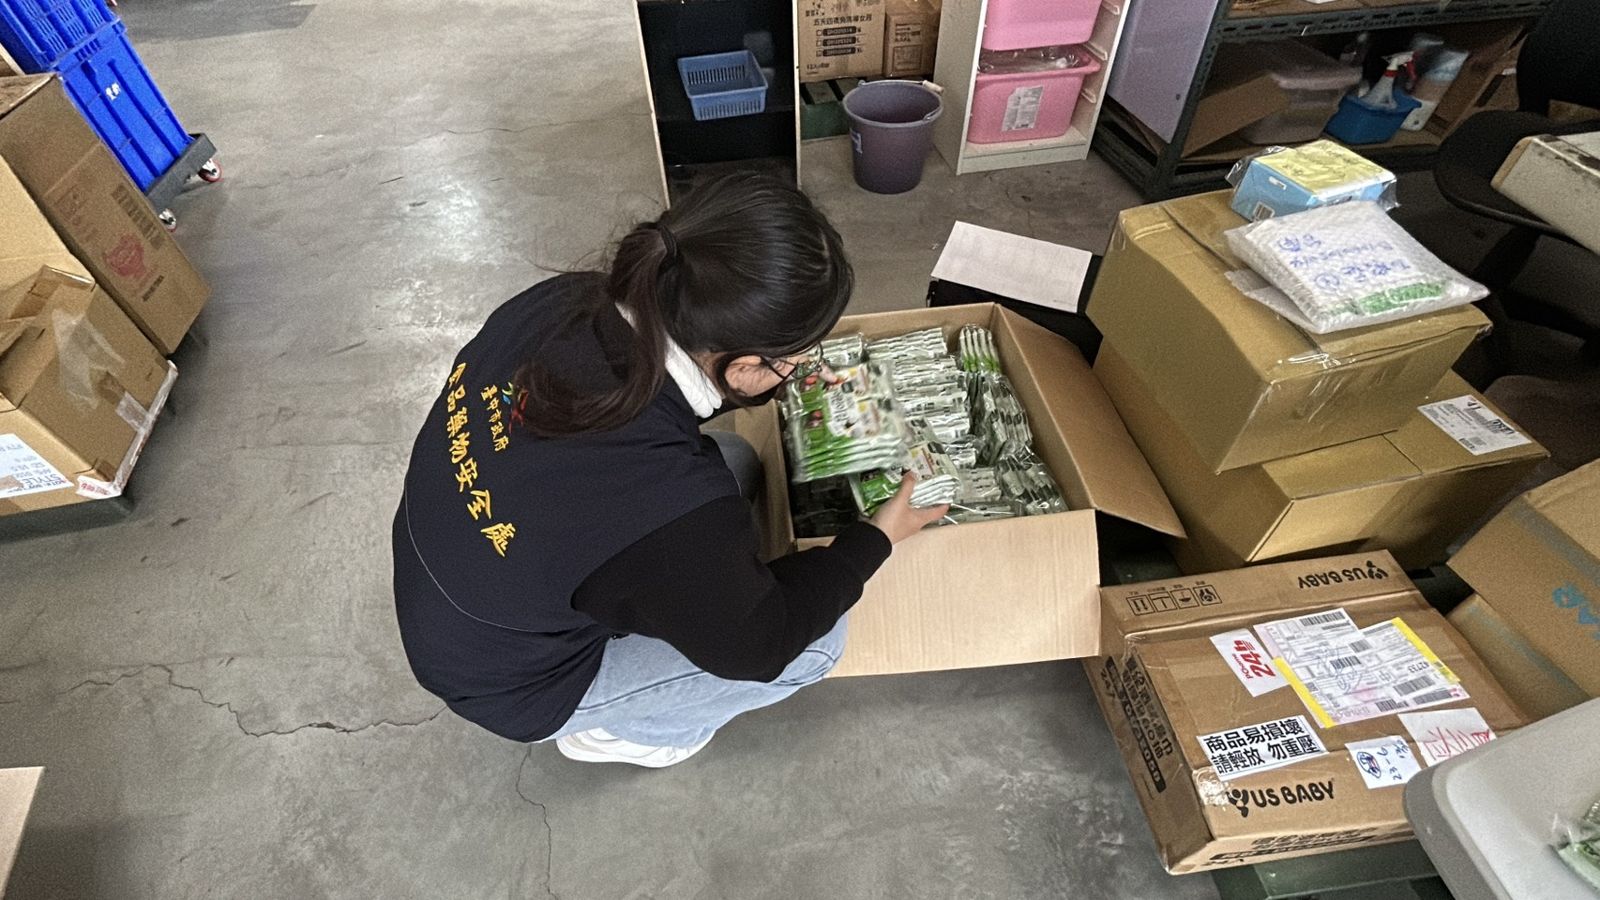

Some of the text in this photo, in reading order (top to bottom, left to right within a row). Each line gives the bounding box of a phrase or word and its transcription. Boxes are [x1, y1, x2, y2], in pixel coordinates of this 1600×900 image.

[481, 385, 509, 451] 臺中市政府
[1298, 567, 1368, 589] US BABY
[1232, 653, 1254, 679] PChome
[1203, 718, 1304, 753] 商品易損壞
[1211, 734, 1320, 774] 請輕放 勿重壓
[1250, 780, 1334, 808] US BABY
